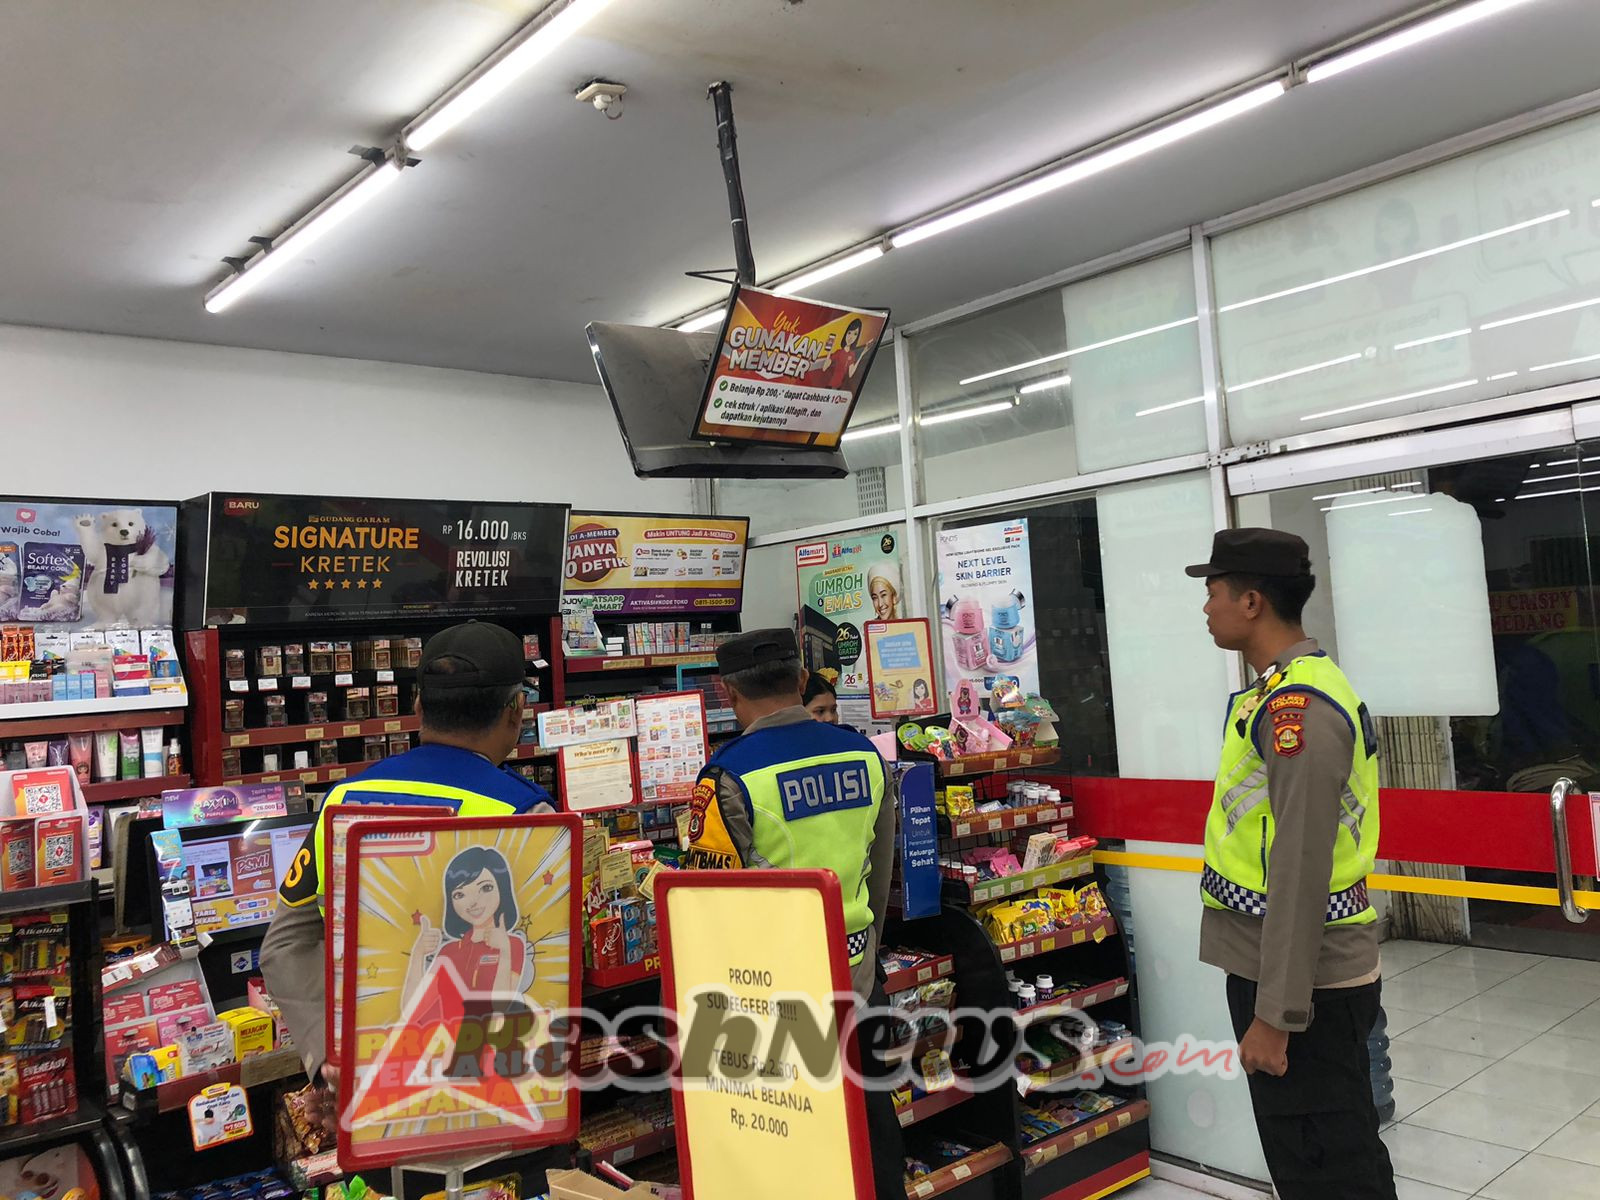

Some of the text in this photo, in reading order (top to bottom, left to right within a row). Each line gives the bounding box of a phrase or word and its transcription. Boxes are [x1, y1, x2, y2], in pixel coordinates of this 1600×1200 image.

[730, 327, 824, 361] GUNAKAN
[728, 349, 811, 379] MEMBER
[730, 384, 756, 396] Belanja
[756, 387, 765, 396] Rp
[784, 390, 802, 400] dapat
[802, 392, 831, 402] Cashback
[724, 400, 736, 409] cek
[737, 401, 756, 410] struk
[760, 404, 785, 415] aplikasi
[811, 409, 821, 417] dan
[720, 412, 788, 426] dapatkan kejutannya
[1, 526, 60, 537] Wajib Coba!
[273, 525, 420, 549] SIGNATURE
[442, 525, 452, 534] RP
[456, 520, 509, 540] 16.000
[580, 530, 616, 539] A-MEMBER
[704, 530, 733, 539] A-MEMBER
[28, 552, 70, 565] Softex
[456, 551, 510, 568] REVOLUSI
[567, 543, 617, 560] ANYA
[799, 547, 825, 557] Alfamart
[300, 556, 391, 573] KRETEK
[582, 557, 629, 574] DETIK
[958, 556, 1007, 569] NEXT LEVEL
[455, 570, 508, 587] KRETEK
[956, 568, 1011, 581] SKIN BARRIER
[815, 573, 863, 595] UMROH
[824, 592, 862, 614] EMAS
[836, 628, 850, 643] 26
[844, 674, 856, 684] 26
[783, 768, 868, 812] POLISI
[910, 806, 930, 814] Pilihan
[911, 816, 931, 826] Tepat
[909, 848, 935, 857] Keluarga
[911, 858, 934, 868] Sehat
[16, 926, 63, 937] Alkaline
[729, 968, 772, 987] PROMO
[713, 1049, 748, 1070] TEBUS
[706, 1076, 813, 1113] MINIMAL BELANJA
[731, 1108, 788, 1137] Rp. 20.000
